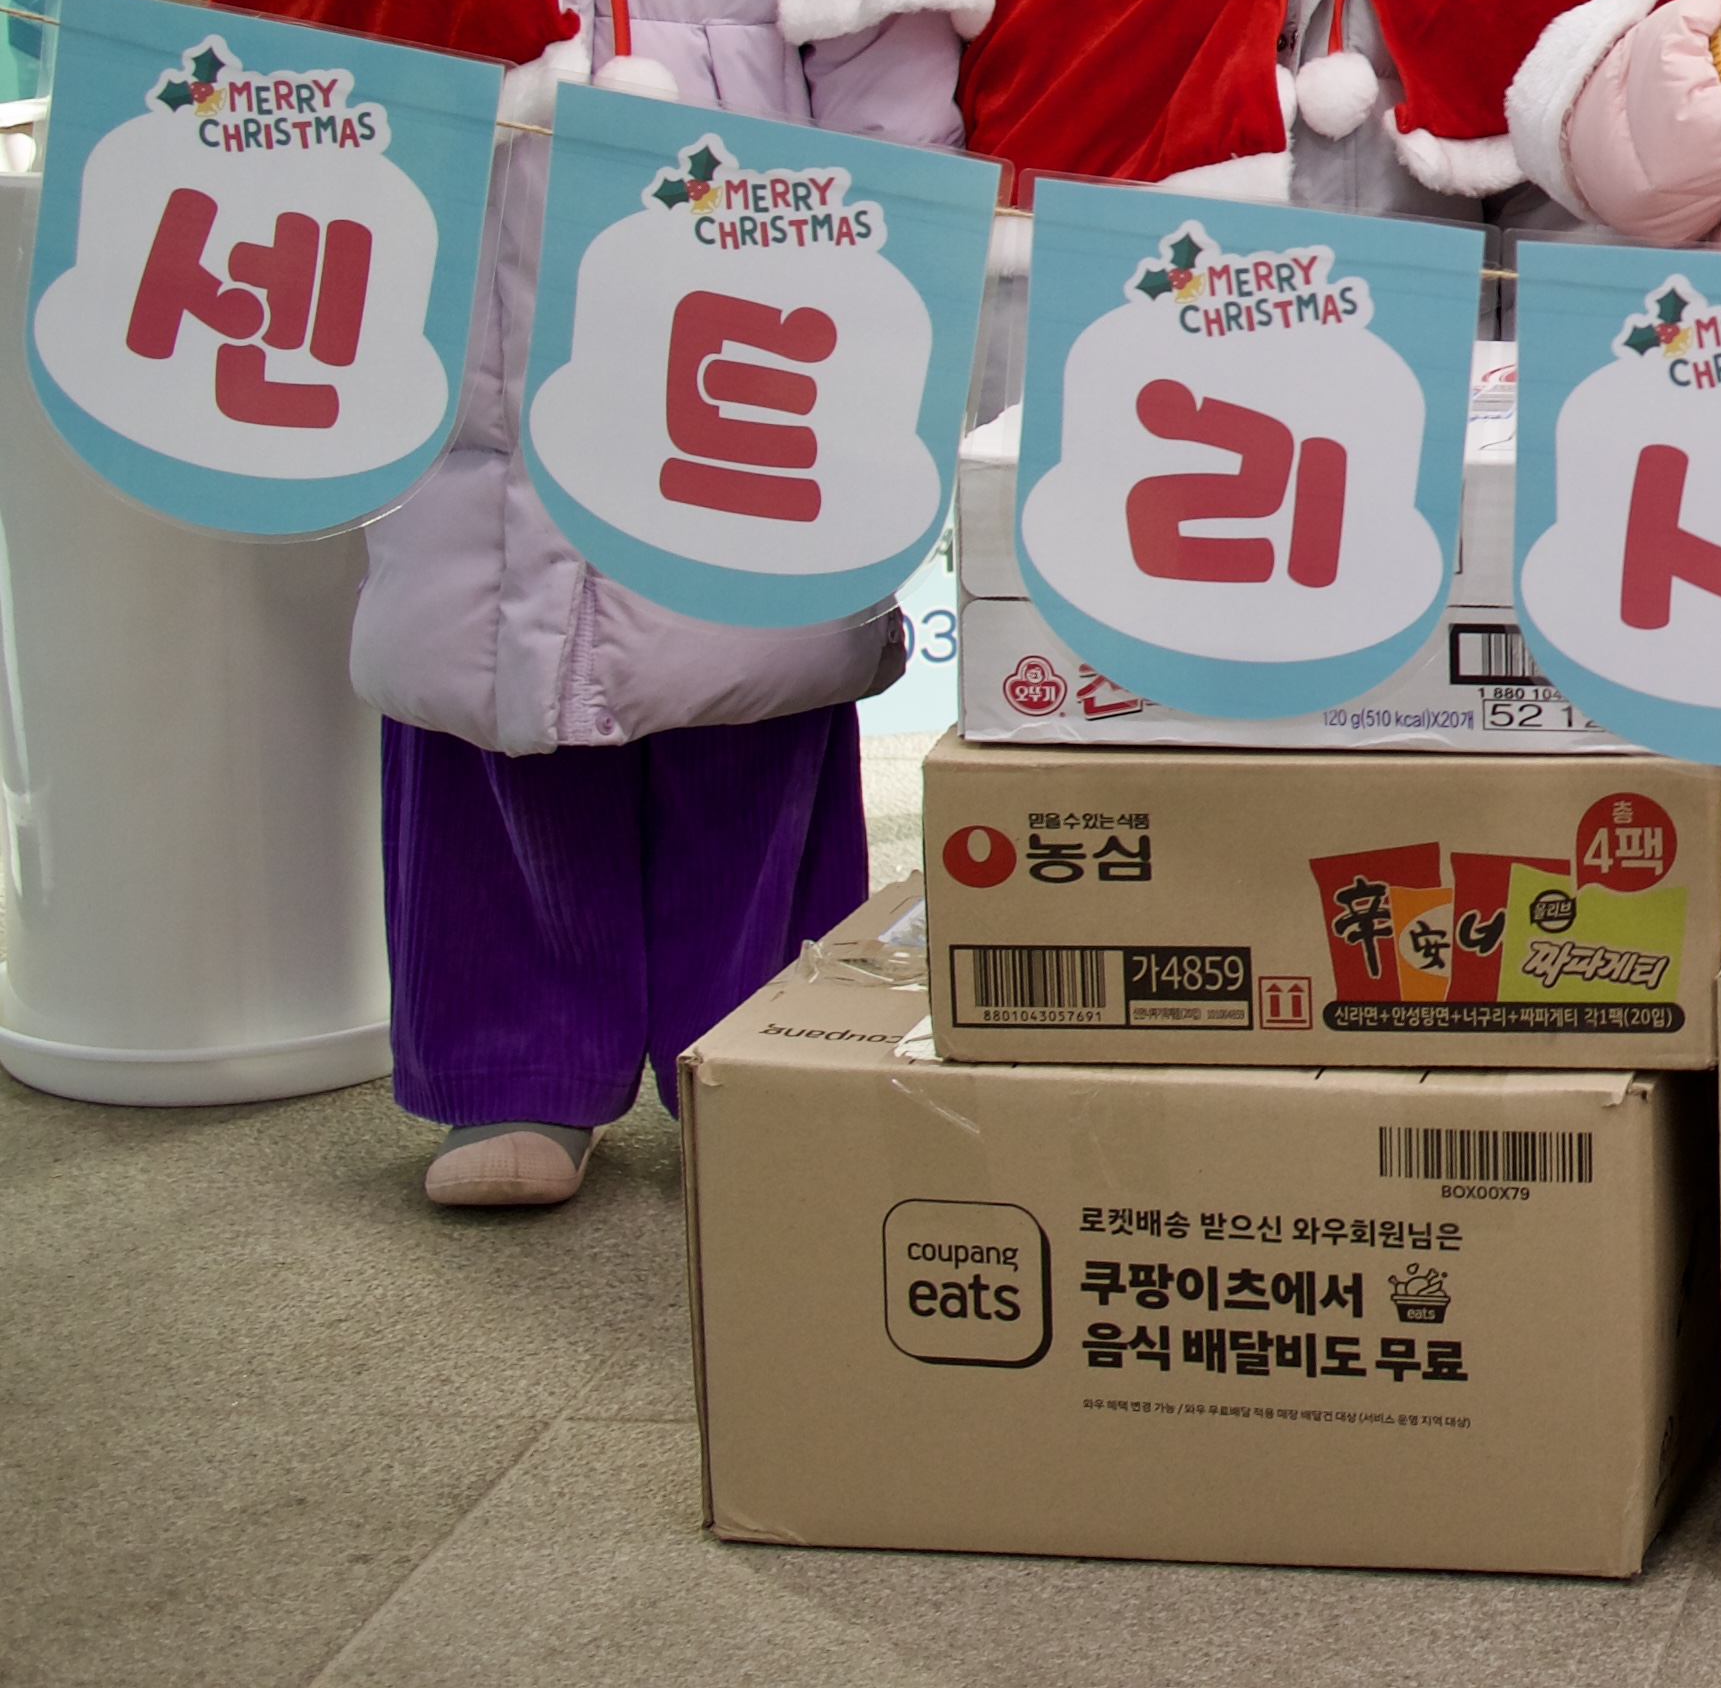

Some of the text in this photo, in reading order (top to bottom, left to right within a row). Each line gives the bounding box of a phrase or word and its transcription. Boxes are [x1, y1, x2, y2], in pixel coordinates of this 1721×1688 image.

[228, 79, 338, 115] MERRY
[199, 111, 377, 153] CHRISTMAS
[725, 176, 836, 213] MERRY
[695, 210, 872, 250] CHRISTMAS
[1207, 254, 1319, 299] MERRY
[125, 188, 373, 429] 센
[1179, 286, 1359, 338] CHRISTMAS
[658, 289, 838, 523] 트
[1125, 378, 1348, 589] 리
[1014, 685, 1056, 703] 오뚜기
[1493, 688, 1525, 700] 880
[1323, 710, 1347, 726] 120
[1489, 703, 1544, 727] 52
[1028, 813, 1151, 831] 믿을 수 있는 식품
[1611, 800, 1634, 824] 총
[1025, 832, 1153, 884] 농심
[1583, 826, 1665, 876] 4팩
[1531, 900, 1574, 923] 올리브
[1131, 952, 1245, 994] 가4859
[1521, 940, 1671, 990] 짜파게티
[759, 1023, 903, 1044] coupang
[983, 1007, 1103, 1023] 8801043057691
[1440, 1184, 1531, 1202] BOX00X79
[1079, 1206, 1464, 1252] 로켓배송 받으신 와우회원님은
[907, 1238, 1020, 1273] coupang
[907, 1272, 1022, 1323] eats
[1080, 1260, 1364, 1319] 쿠팡이츠에서
[1406, 1306, 1437, 1321] eats
[1081, 1322, 1470, 1383] 음식 배달비도 무료
